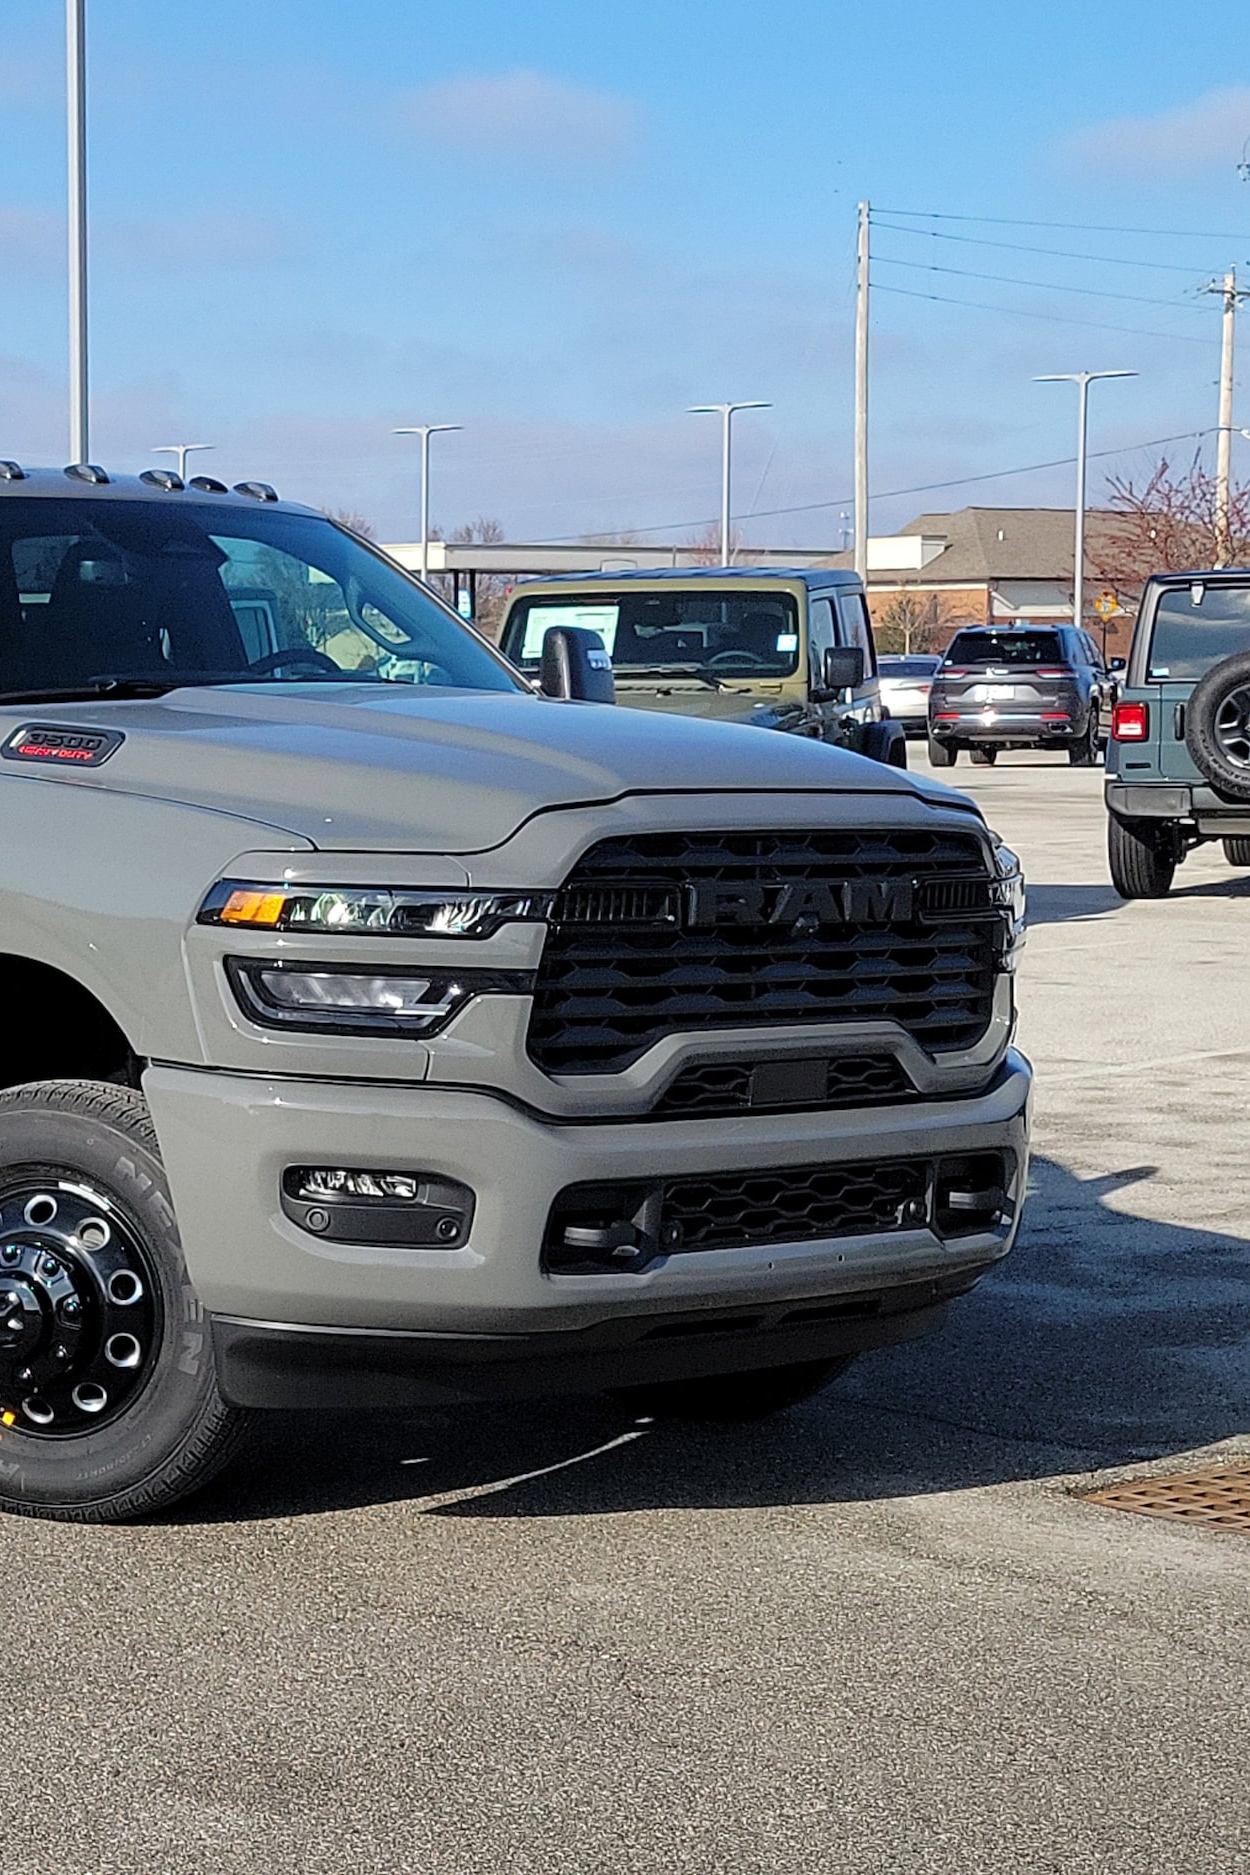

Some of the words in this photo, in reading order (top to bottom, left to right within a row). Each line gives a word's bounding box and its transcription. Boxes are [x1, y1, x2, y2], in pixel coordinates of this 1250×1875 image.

[28, 733, 103, 751] 3500
[58, 749, 93, 760] DUTY
[687, 880, 912, 925] RAM
